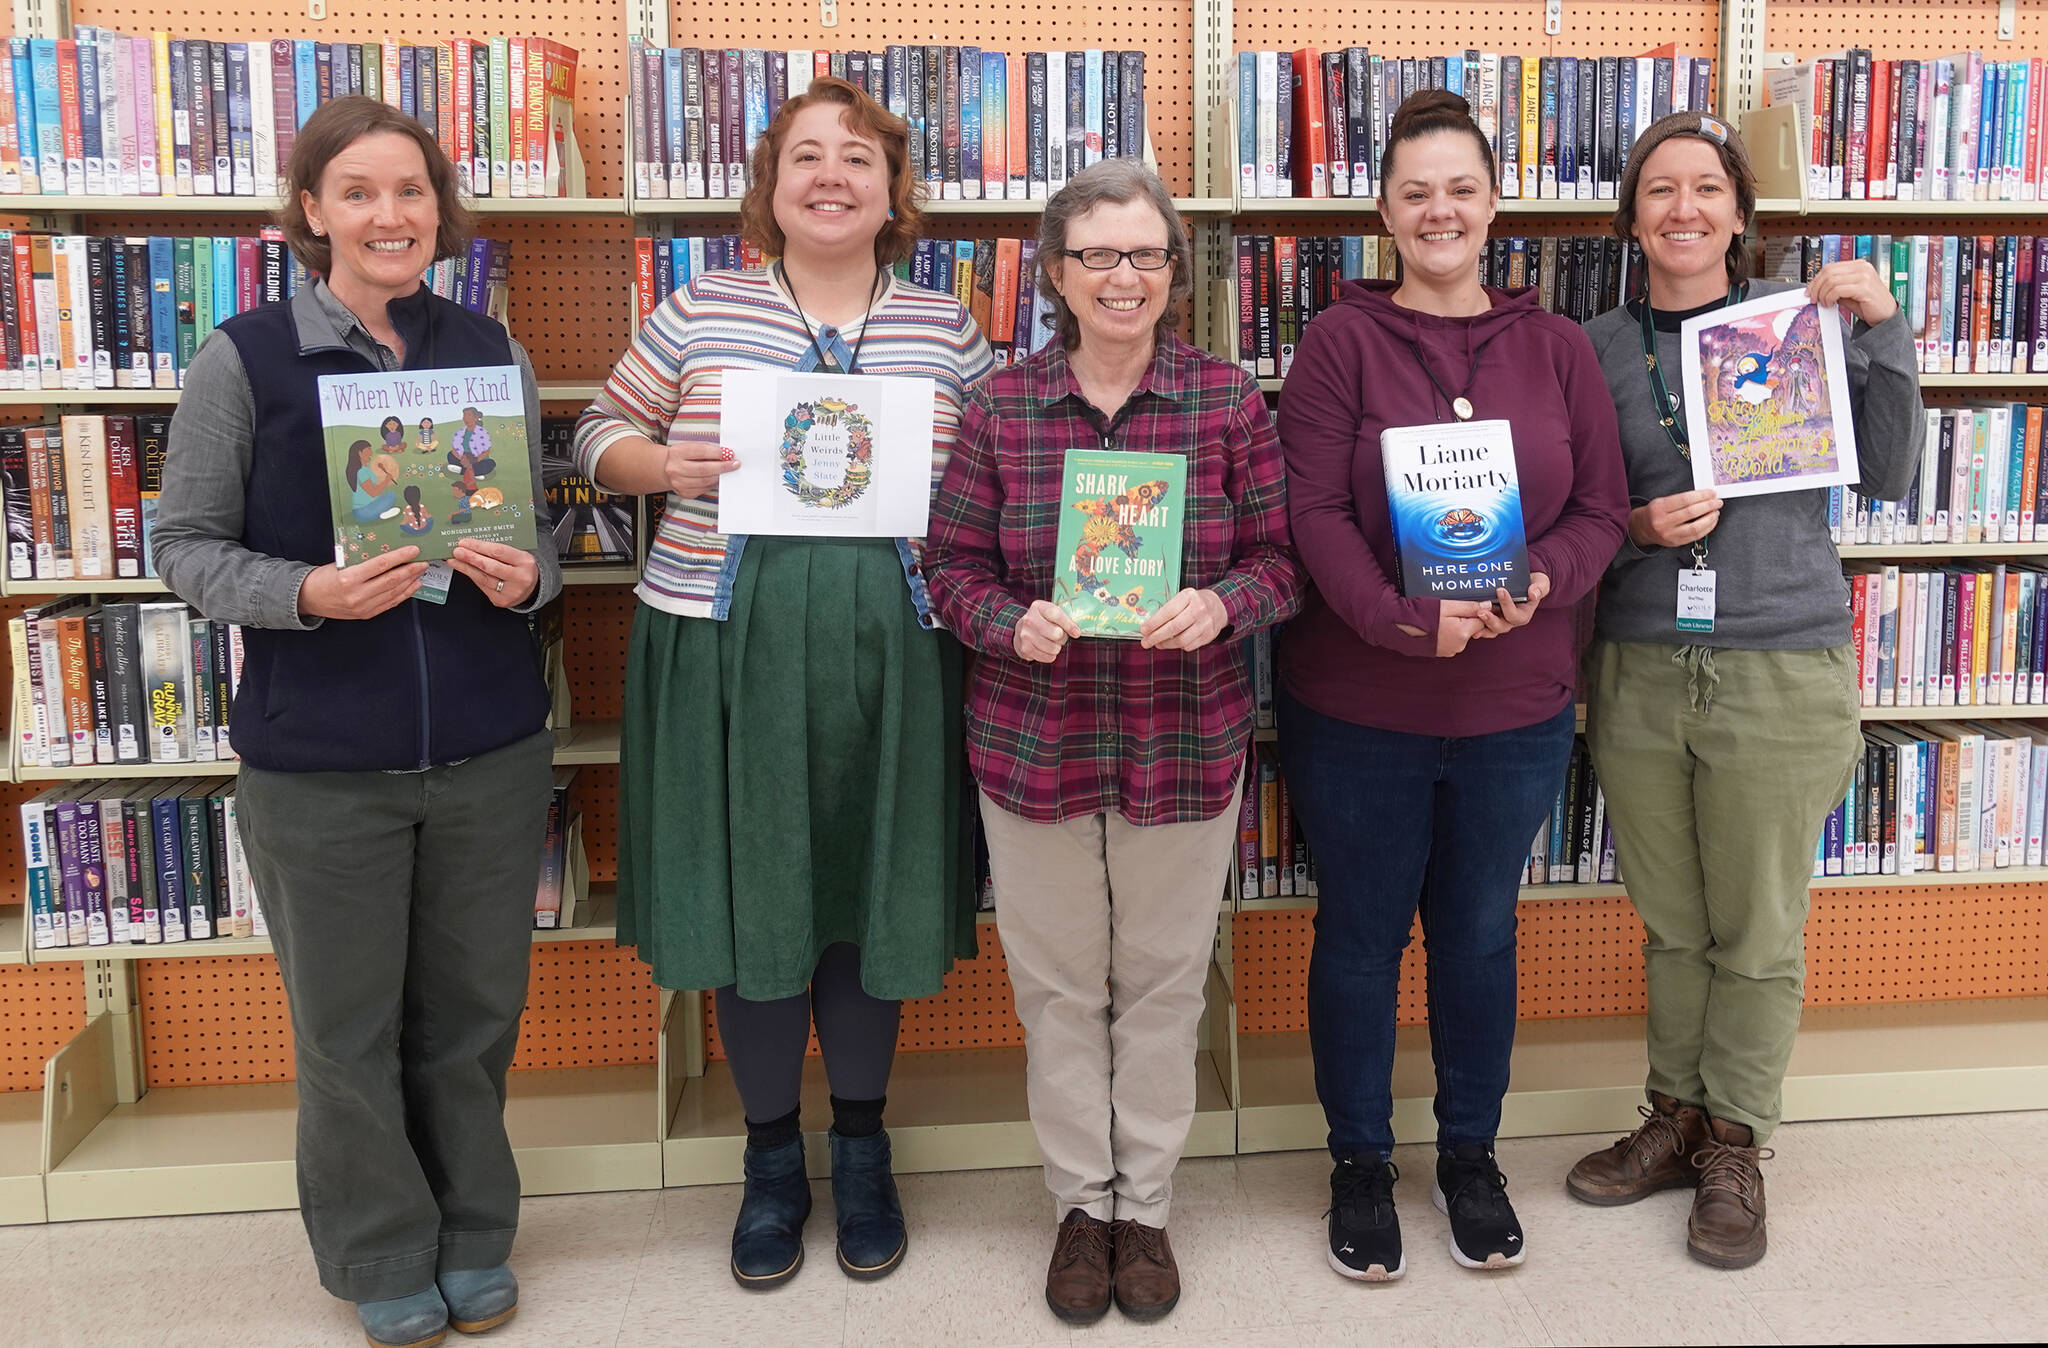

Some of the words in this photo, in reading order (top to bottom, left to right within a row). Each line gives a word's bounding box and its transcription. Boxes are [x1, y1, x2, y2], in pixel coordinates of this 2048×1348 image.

[81, 48, 91, 61] THE
[385, 41, 396, 63] JANET
[458, 41, 468, 64] Janet
[493, 39, 504, 62] Janet
[511, 44, 523, 68] JANET
[893, 47, 902, 69] JOHN
[929, 50, 938, 71] JOHN
[82, 63, 93, 86] GLASS
[193, 60, 202, 82] GOOD
[214, 61, 225, 91] SHUTTER
[528, 50, 544, 79] JANET
[688, 64, 696, 83] ZANE
[911, 52, 921, 75] JOHN
[946, 54, 955, 80] JOHN
[62, 63, 74, 103] TARTAN
[303, 81, 311, 107] Erdrich
[440, 69, 452, 106] EVANOVICH
[459, 66, 470, 106] Evanovich
[494, 64, 505, 106] Evanovich
[511, 69, 525, 108] EVANOVICH
[689, 84, 697, 102] GREY
[894, 71, 903, 106] GRISHAM
[912, 76, 921, 115] GRISHAM
[929, 75, 938, 113] GRISHAM
[962, 67, 971, 104] GRISHAM
[1483, 78, 1494, 111] JANCE
[1604, 73, 1612, 93] LISA
[1854, 73, 1867, 101] ROBERT
[194, 85, 203, 110] GIRLS
[476, 86, 487, 126] EVANOVICH
[528, 81, 544, 130] EVANOVICH
[947, 85, 956, 131] GRISHAM
[1527, 95, 1536, 125] JANCE
[1546, 91, 1554, 115] JANCE
[1905, 88, 1914, 121] PERFECT
[196, 113, 204, 126] LIE
[1604, 95, 1612, 129] JEWELL
[1854, 103, 1867, 132] LUDLUM
[459, 110, 470, 148] Notorious
[514, 116, 522, 138] TRICKY
[962, 124, 970, 151] MERCY
[1034, 113, 1042, 137] FATES
[1108, 127, 1115, 136] A
[122, 134, 136, 170] VERA
[929, 126, 939, 166] ROOSTER
[1508, 139, 1516, 160] LIST
[948, 141, 956, 182] SOOLEY
[1034, 149, 1042, 176] FURIES
[267, 243, 279, 259] JOY
[923, 254, 931, 273] LADY
[1, 255, 13, 278] The
[472, 257, 481, 282] JOANNE
[640, 254, 652, 279] Drunk
[660, 260, 669, 283] Signs
[914, 255, 922, 283] BONES
[1240, 256, 1252, 274] IRIS
[1281, 258, 1293, 282] STORM
[115, 254, 127, 308] SOMETIMES
[267, 261, 280, 302] FIELDING
[1260, 270, 1268, 305] JOHANSEN
[4, 282, 15, 326] Locket
[94, 289, 104, 315] HERS
[470, 285, 478, 305] FLUKE
[642, 292, 653, 311] Love
[1240, 276, 1252, 322] JOHANSEN
[1282, 285, 1294, 307] CYCLE
[1260, 307, 1269, 328] DARK
[2039, 297, 2048, 329] BOMBAY
[118, 320, 128, 333] LIE
[332, 383, 390, 412] When
[393, 381, 424, 407] We
[430, 379, 459, 406] Are
[464, 374, 511, 403] Kind
[1708, 399, 1776, 427] Nicola
[79, 435, 92, 458] KEN
[814, 433, 841, 441] Little
[2014, 428, 2025, 463] PAULA
[110, 435, 123, 477] FOLLETT
[121, 446, 131, 466] KEN
[811, 446, 844, 454] Weirds
[1419, 444, 1489, 466] Liane
[51, 455, 62, 491] SURVIVOR
[144, 439, 160, 490] FOLLETT
[812, 459, 840, 468] Jenny
[82, 462, 95, 513] FOLLETT
[561, 476, 591, 486] GUIL
[1075, 472, 1128, 496] SHARK
[1402, 470, 1511, 494] Moriarty
[52, 495, 60, 516] FLYNN
[1118, 504, 1168, 528] HEART
[114, 508, 136, 549] NEVER
[1069, 554, 1077, 572] A
[1089, 556, 1119, 575] LOVE
[1124, 558, 1163, 577] STORY
[1422, 563, 1469, 576] HERE
[1477, 561, 1513, 573] ONE
[1431, 577, 1508, 592] MOMENT
[1680, 584, 1713, 593] Charlotte
[26, 614, 40, 644] ALAN
[233, 631, 241, 646] LISA
[68, 637, 82, 655] The
[1960, 639, 1968, 674] MILLER
[29, 647, 42, 683] FURST
[68, 656, 84, 690] Refuge
[115, 647, 127, 676] calling
[95, 680, 106, 699] JUST
[80, 701, 88, 715] ANN
[98, 702, 107, 720] LIKE
[163, 682, 177, 735] RUNNING
[78, 820, 87, 839] TOO
[88, 819, 99, 838] ONE
[127, 820, 136, 845] Allegra
[162, 817, 171, 832] SUE
[190, 816, 198, 832] SUE
[1583, 814, 1591, 836] TRAIL
[1959, 802, 1971, 840] MORRISON
[29, 822, 42, 863] MONK
[80, 840, 90, 865] MANY
[90, 839, 101, 863] TASTE
[106, 821, 124, 859] NEST
[163, 832, 174, 868] GRAFTON
[191, 832, 201, 870] GRAFTON
[130, 847, 138, 882] Goodman
